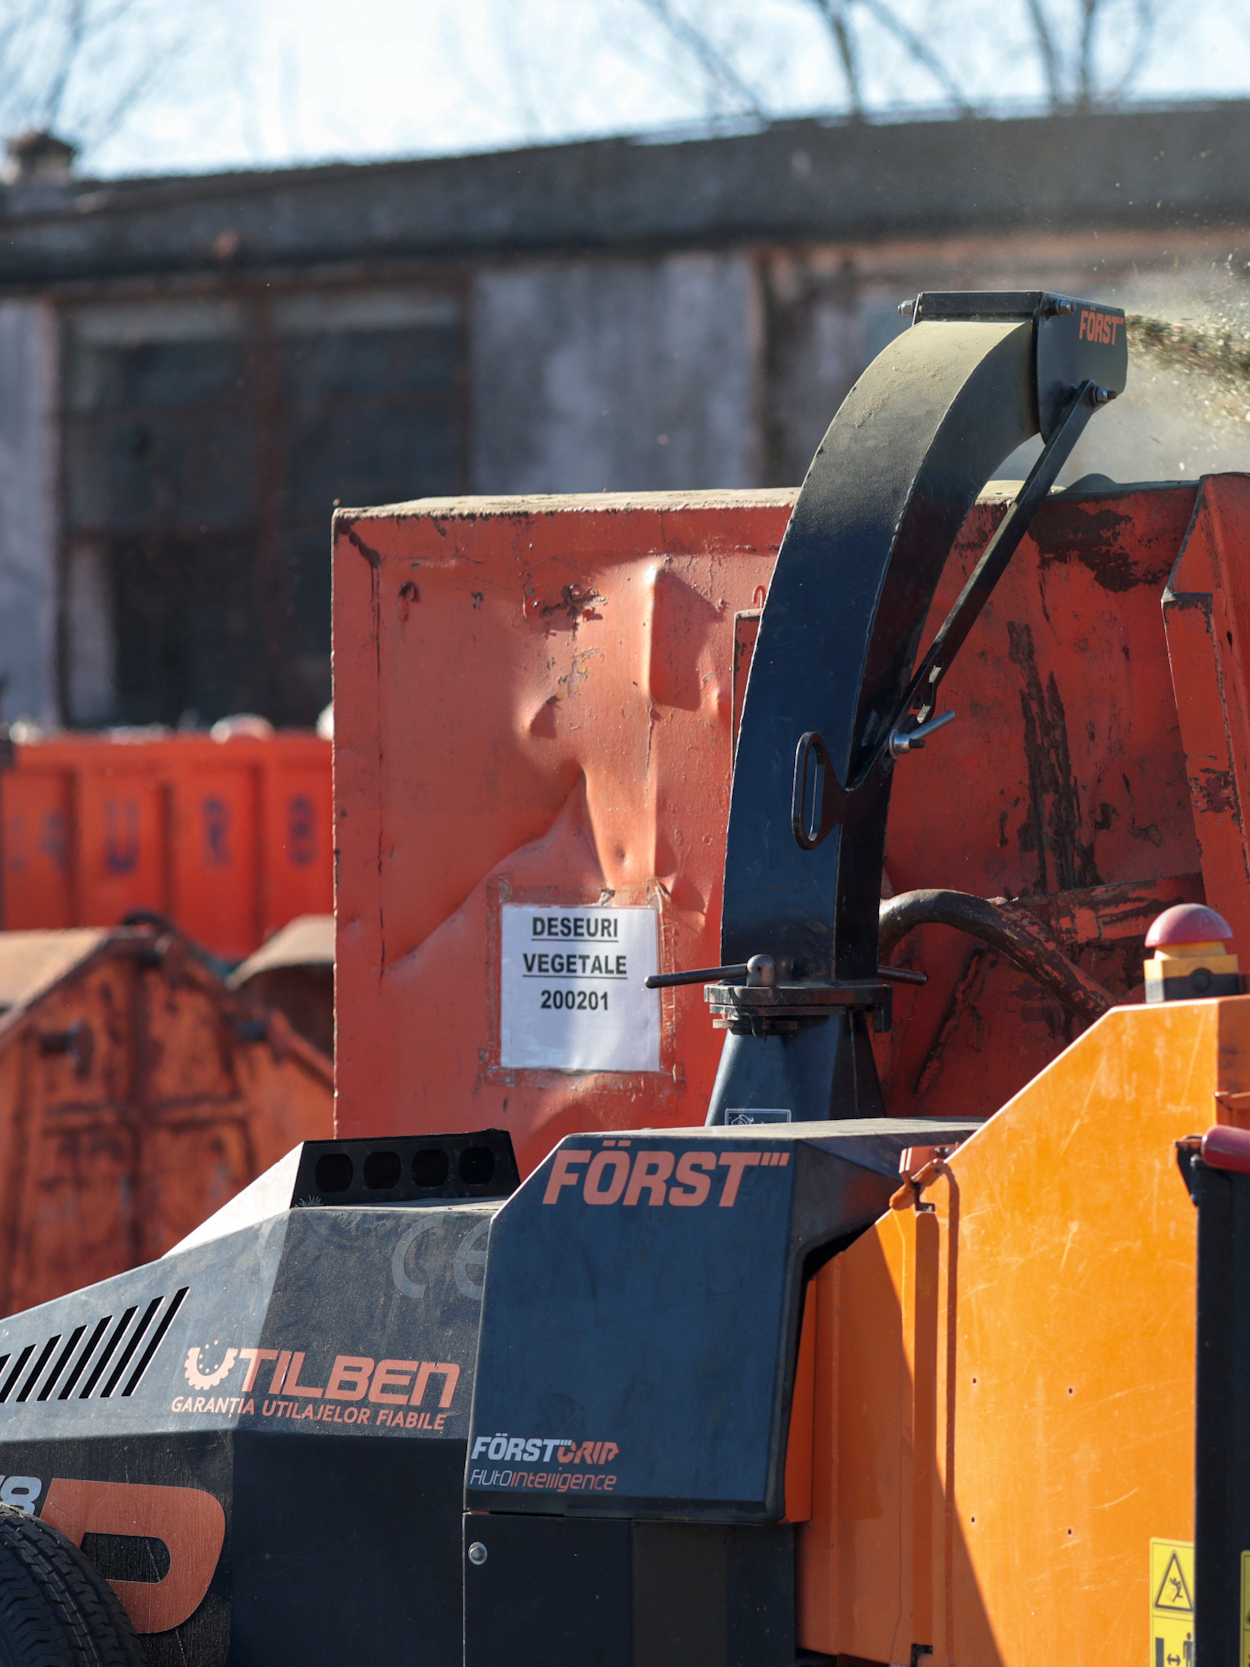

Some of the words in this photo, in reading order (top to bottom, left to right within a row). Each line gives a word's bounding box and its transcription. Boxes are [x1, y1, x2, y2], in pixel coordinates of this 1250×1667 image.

[1078, 306, 1124, 345] FÖRST
[532, 916, 618, 938] DESEURI
[522, 953, 627, 975] VEGETALE
[540, 990, 608, 1011] 200201
[542, 1139, 790, 1207] FÖRST
[171, 1396, 255, 1418] GARANȚIA
[262, 1400, 371, 1425] UTILAJELOR
[376, 1409, 447, 1431] FIABILE
